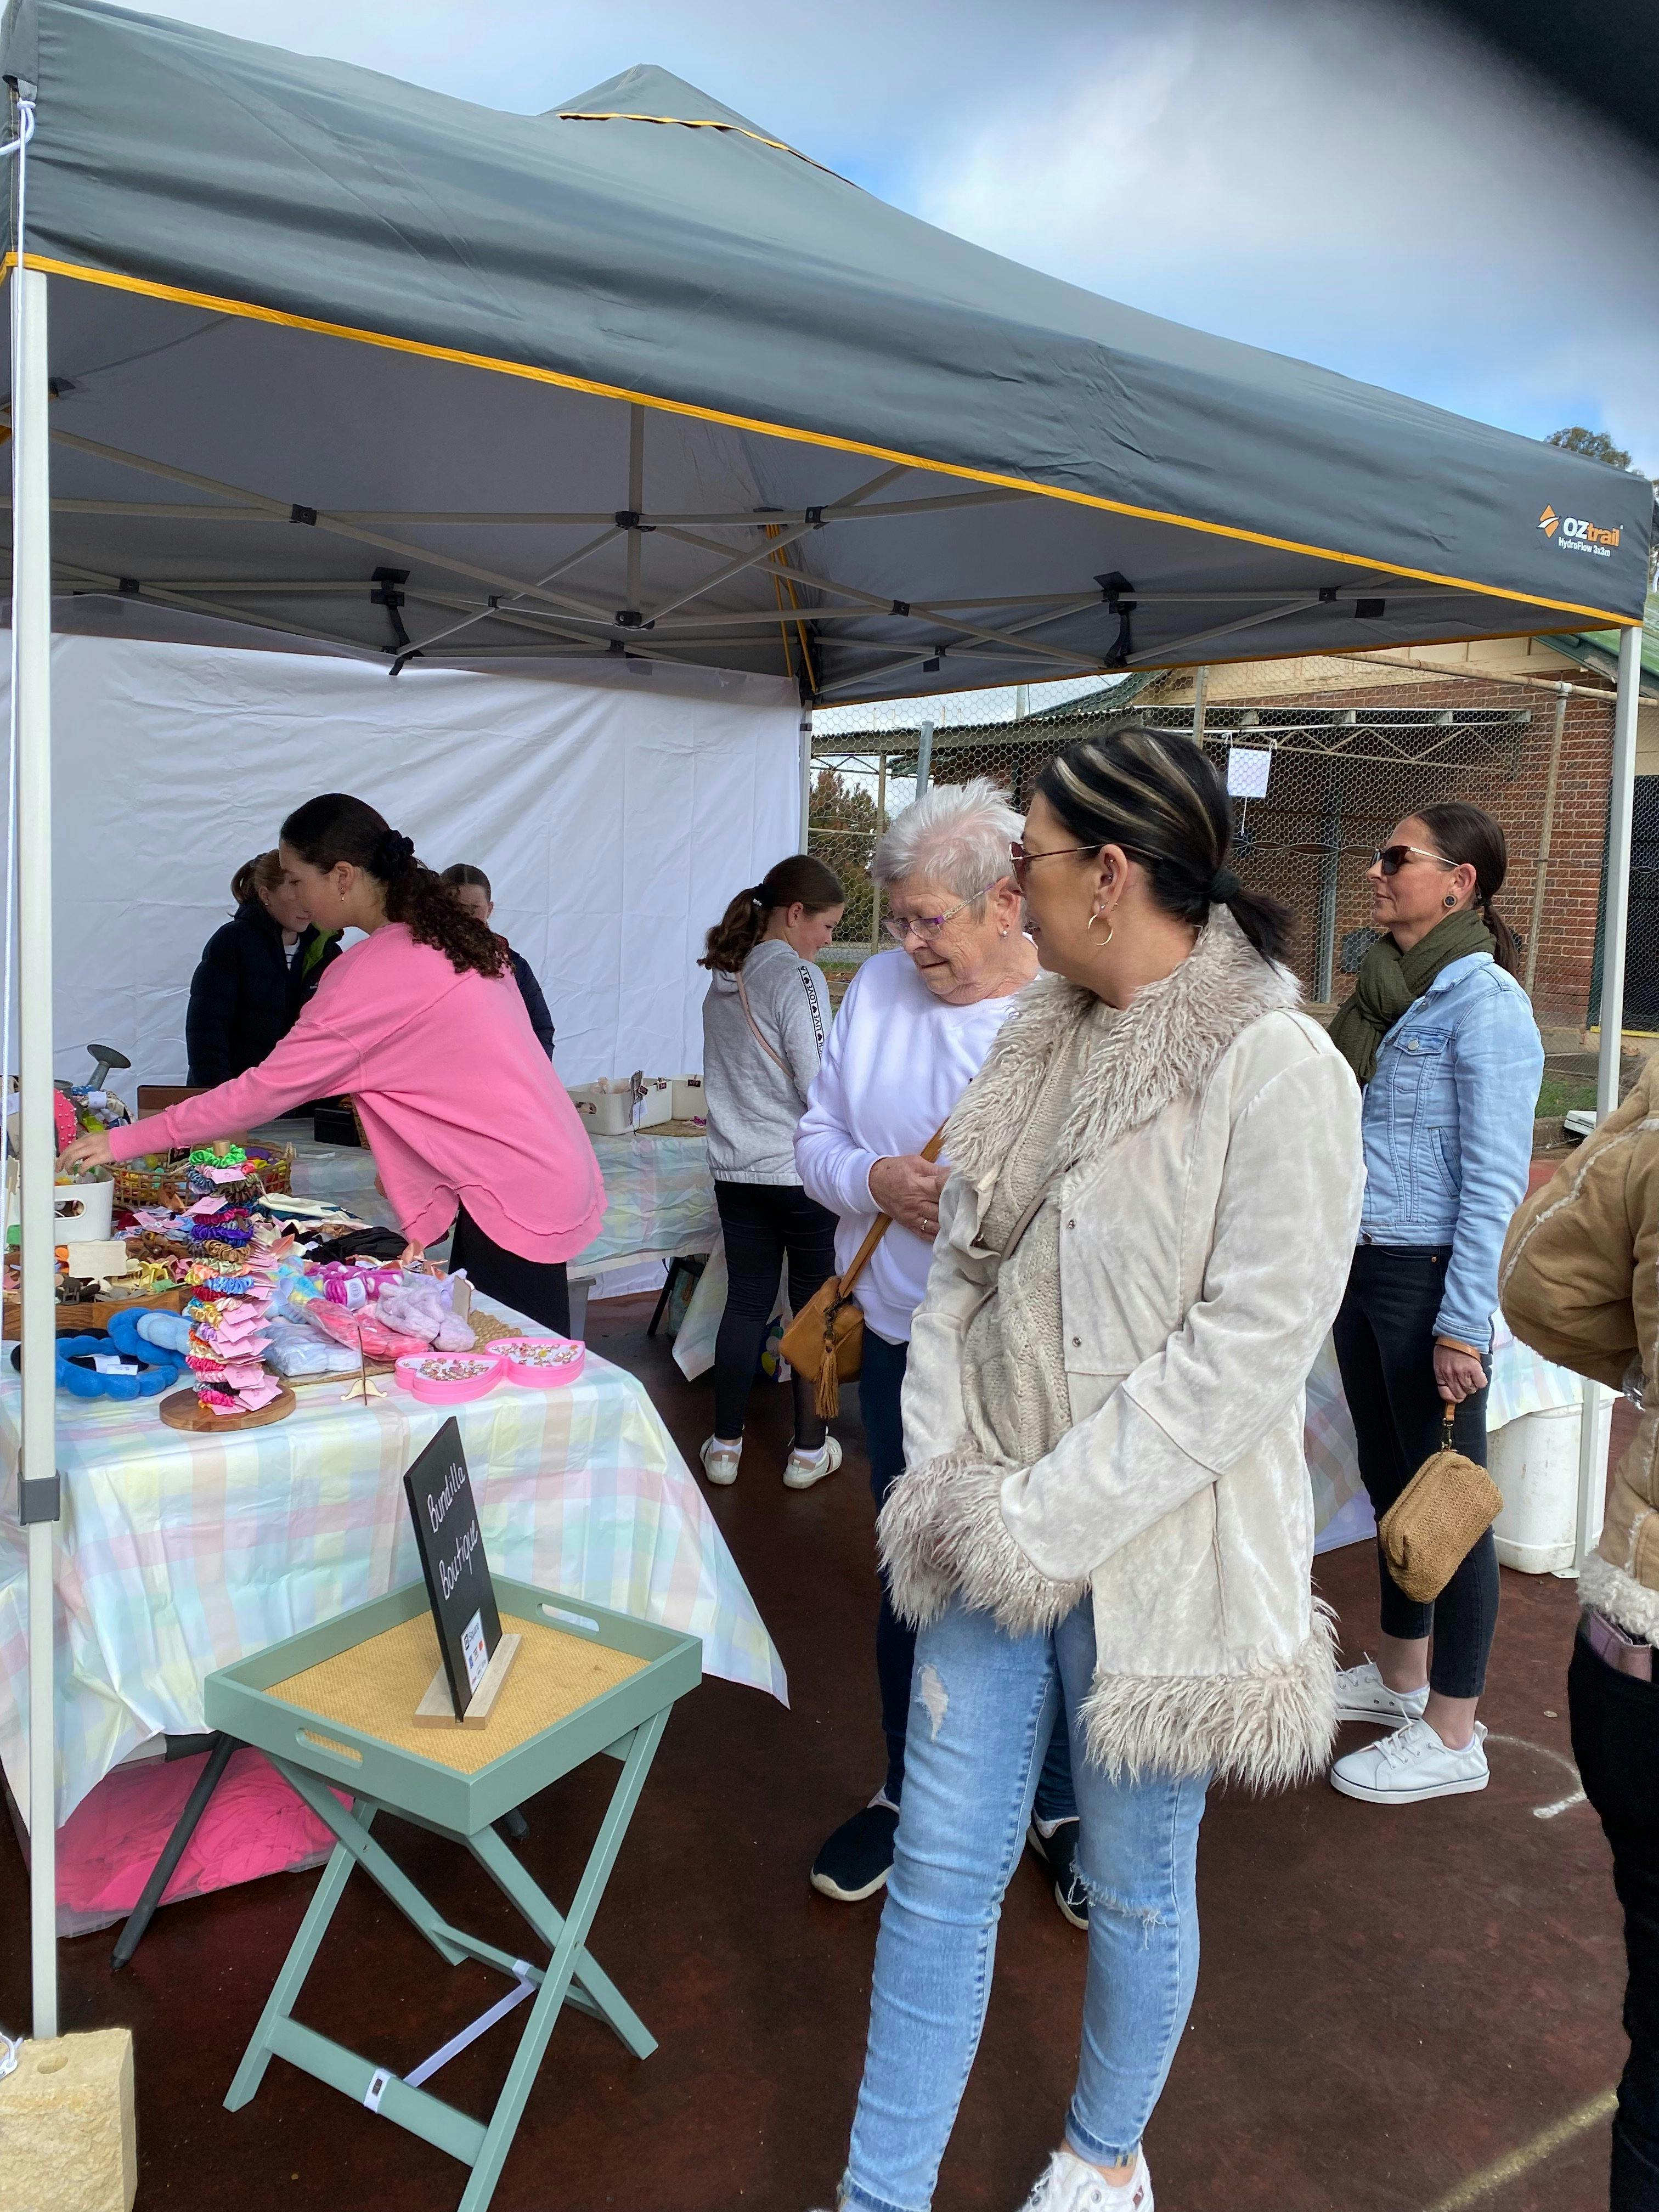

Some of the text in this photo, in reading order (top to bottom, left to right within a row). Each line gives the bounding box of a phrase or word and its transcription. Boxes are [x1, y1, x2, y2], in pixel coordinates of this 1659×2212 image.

[1563, 517, 1621, 547] OZtrail
[1559, 537, 1611, 557] HydroFlow 3x3m
[807, 985, 816, 1005] LOVE
[813, 1015, 822, 1031] LIVE
[427, 1462, 466, 1533] Bundilla
[439, 1519, 479, 1601] Boutique
